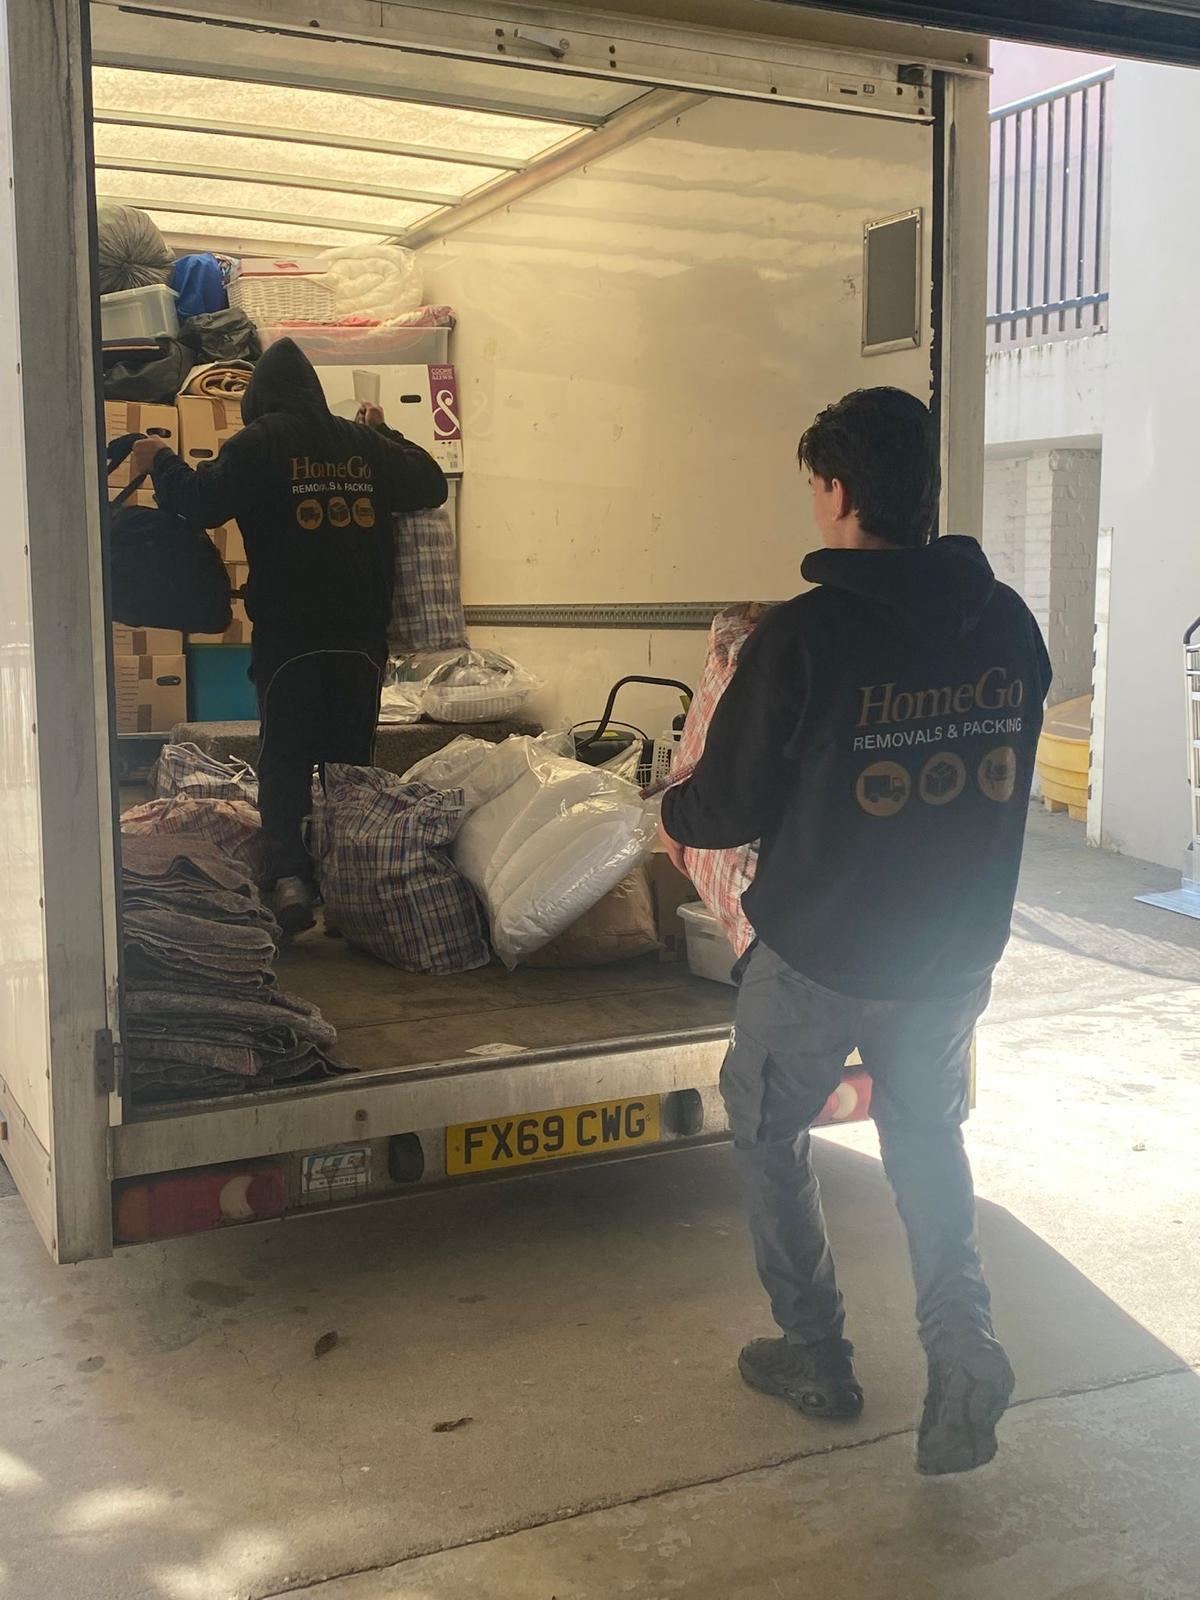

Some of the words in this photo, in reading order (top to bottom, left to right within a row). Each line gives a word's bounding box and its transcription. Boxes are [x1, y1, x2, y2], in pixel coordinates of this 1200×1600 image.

[292, 481, 336, 494] REMOS
[856, 666, 1023, 727] HomeGo
[853, 726, 943, 751] REMOVALS
[947, 723, 958, 739] &
[963, 717, 1022, 737] PACKING
[464, 1115, 564, 1165] FX69
[576, 1102, 646, 1147] CWG
